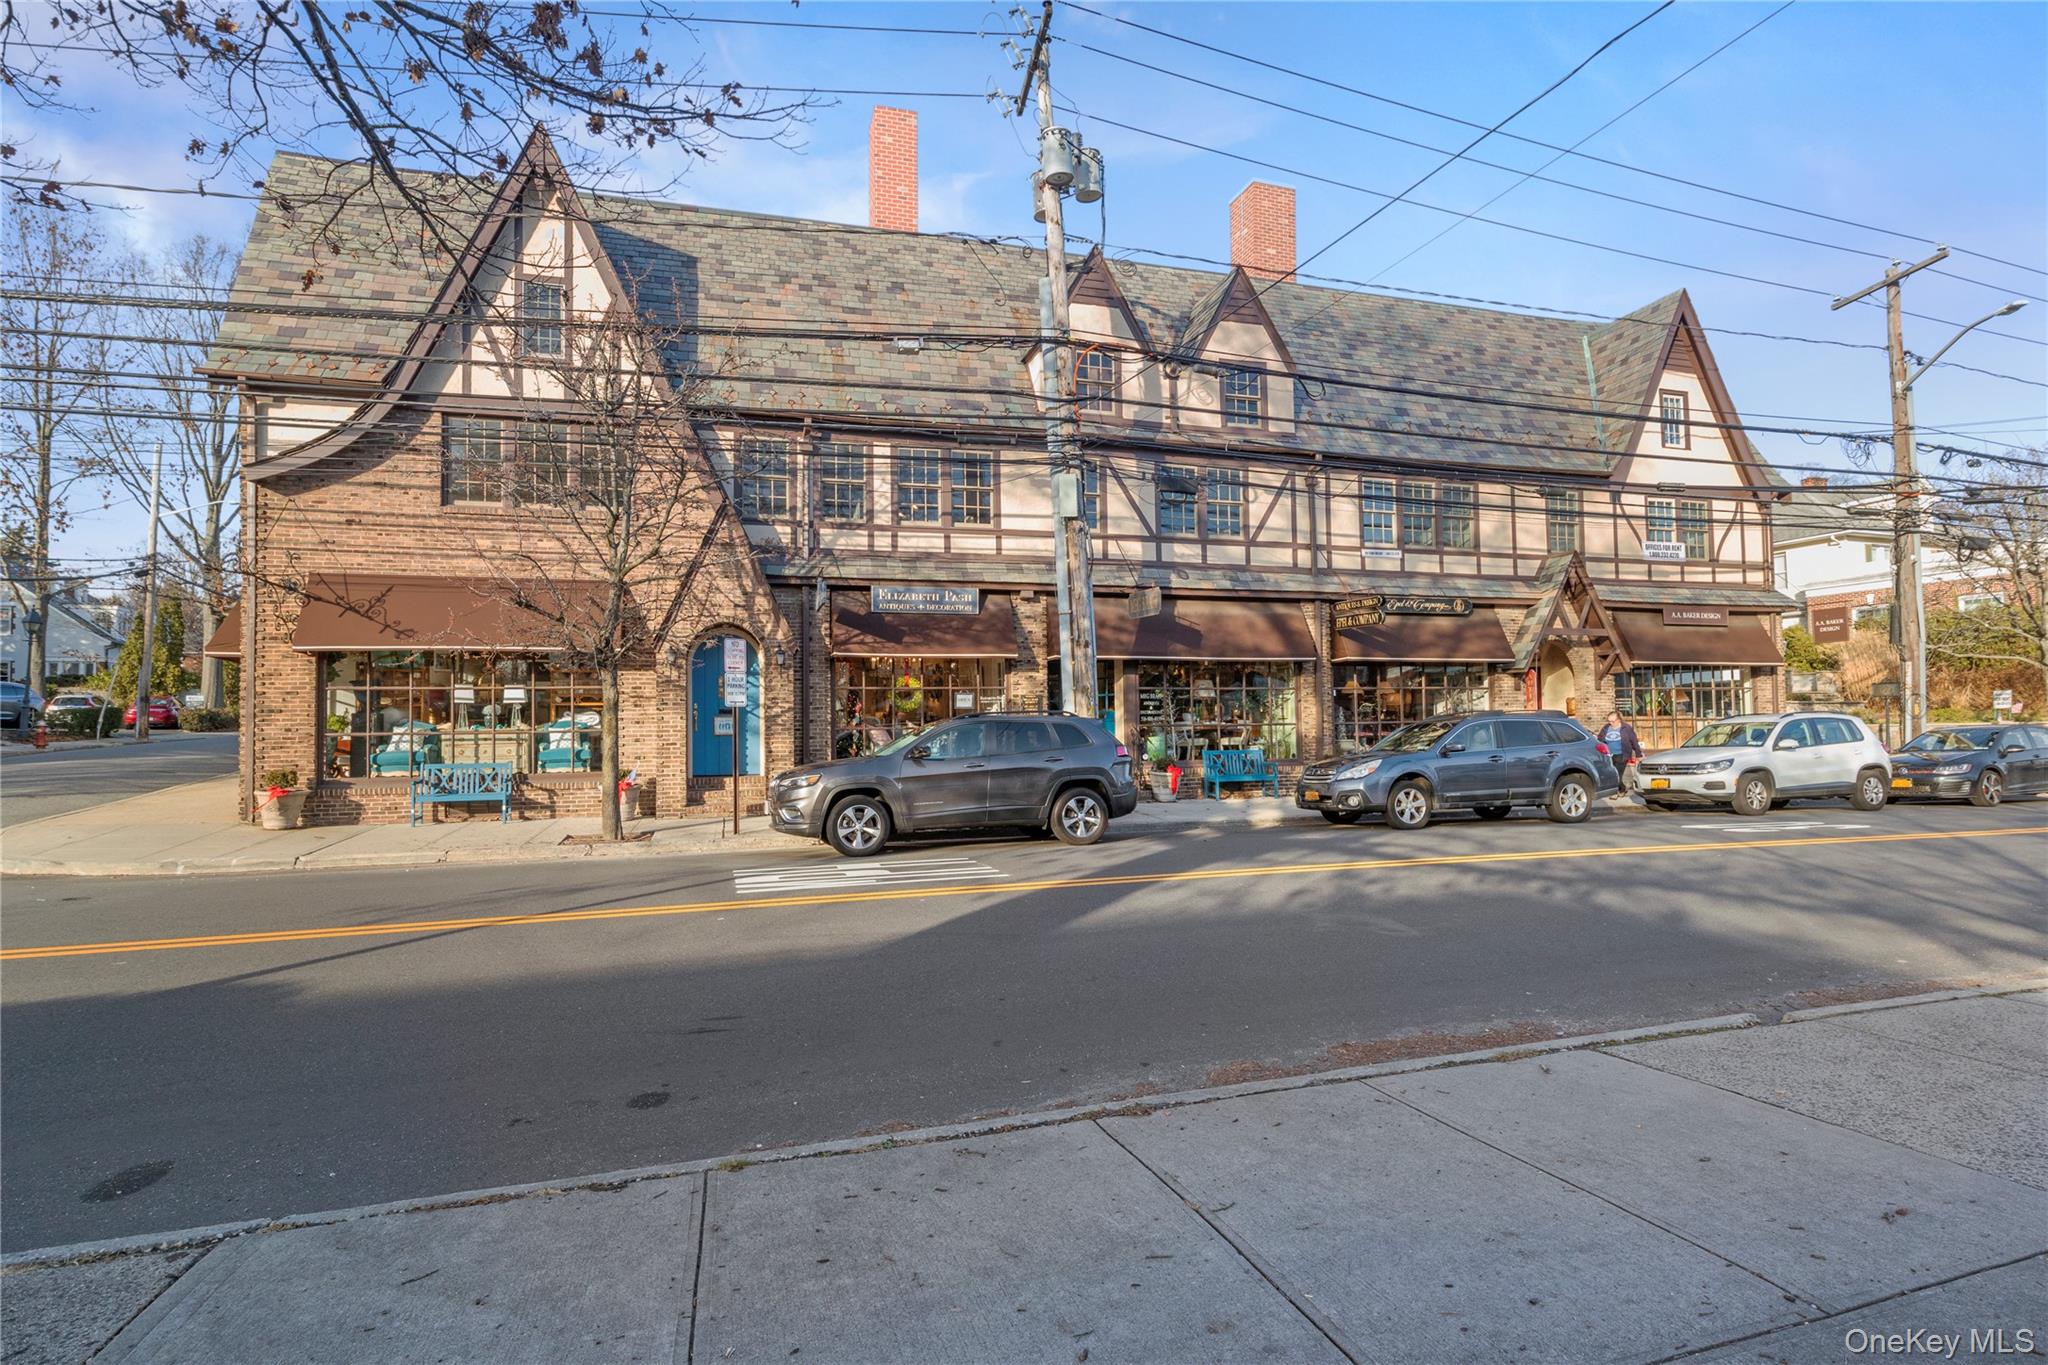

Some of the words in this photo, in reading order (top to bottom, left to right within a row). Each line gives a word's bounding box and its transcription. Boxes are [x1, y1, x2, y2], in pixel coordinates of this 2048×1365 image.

[1662, 544, 1671, 552] FOR
[878, 588, 940, 601] ELIZABETH
[944, 590, 973, 602] PASH
[878, 603, 915, 611] ANTIQUES
[1353, 612, 1380, 625] COMPANY
[1700, 612, 1721, 620] DESIGN
